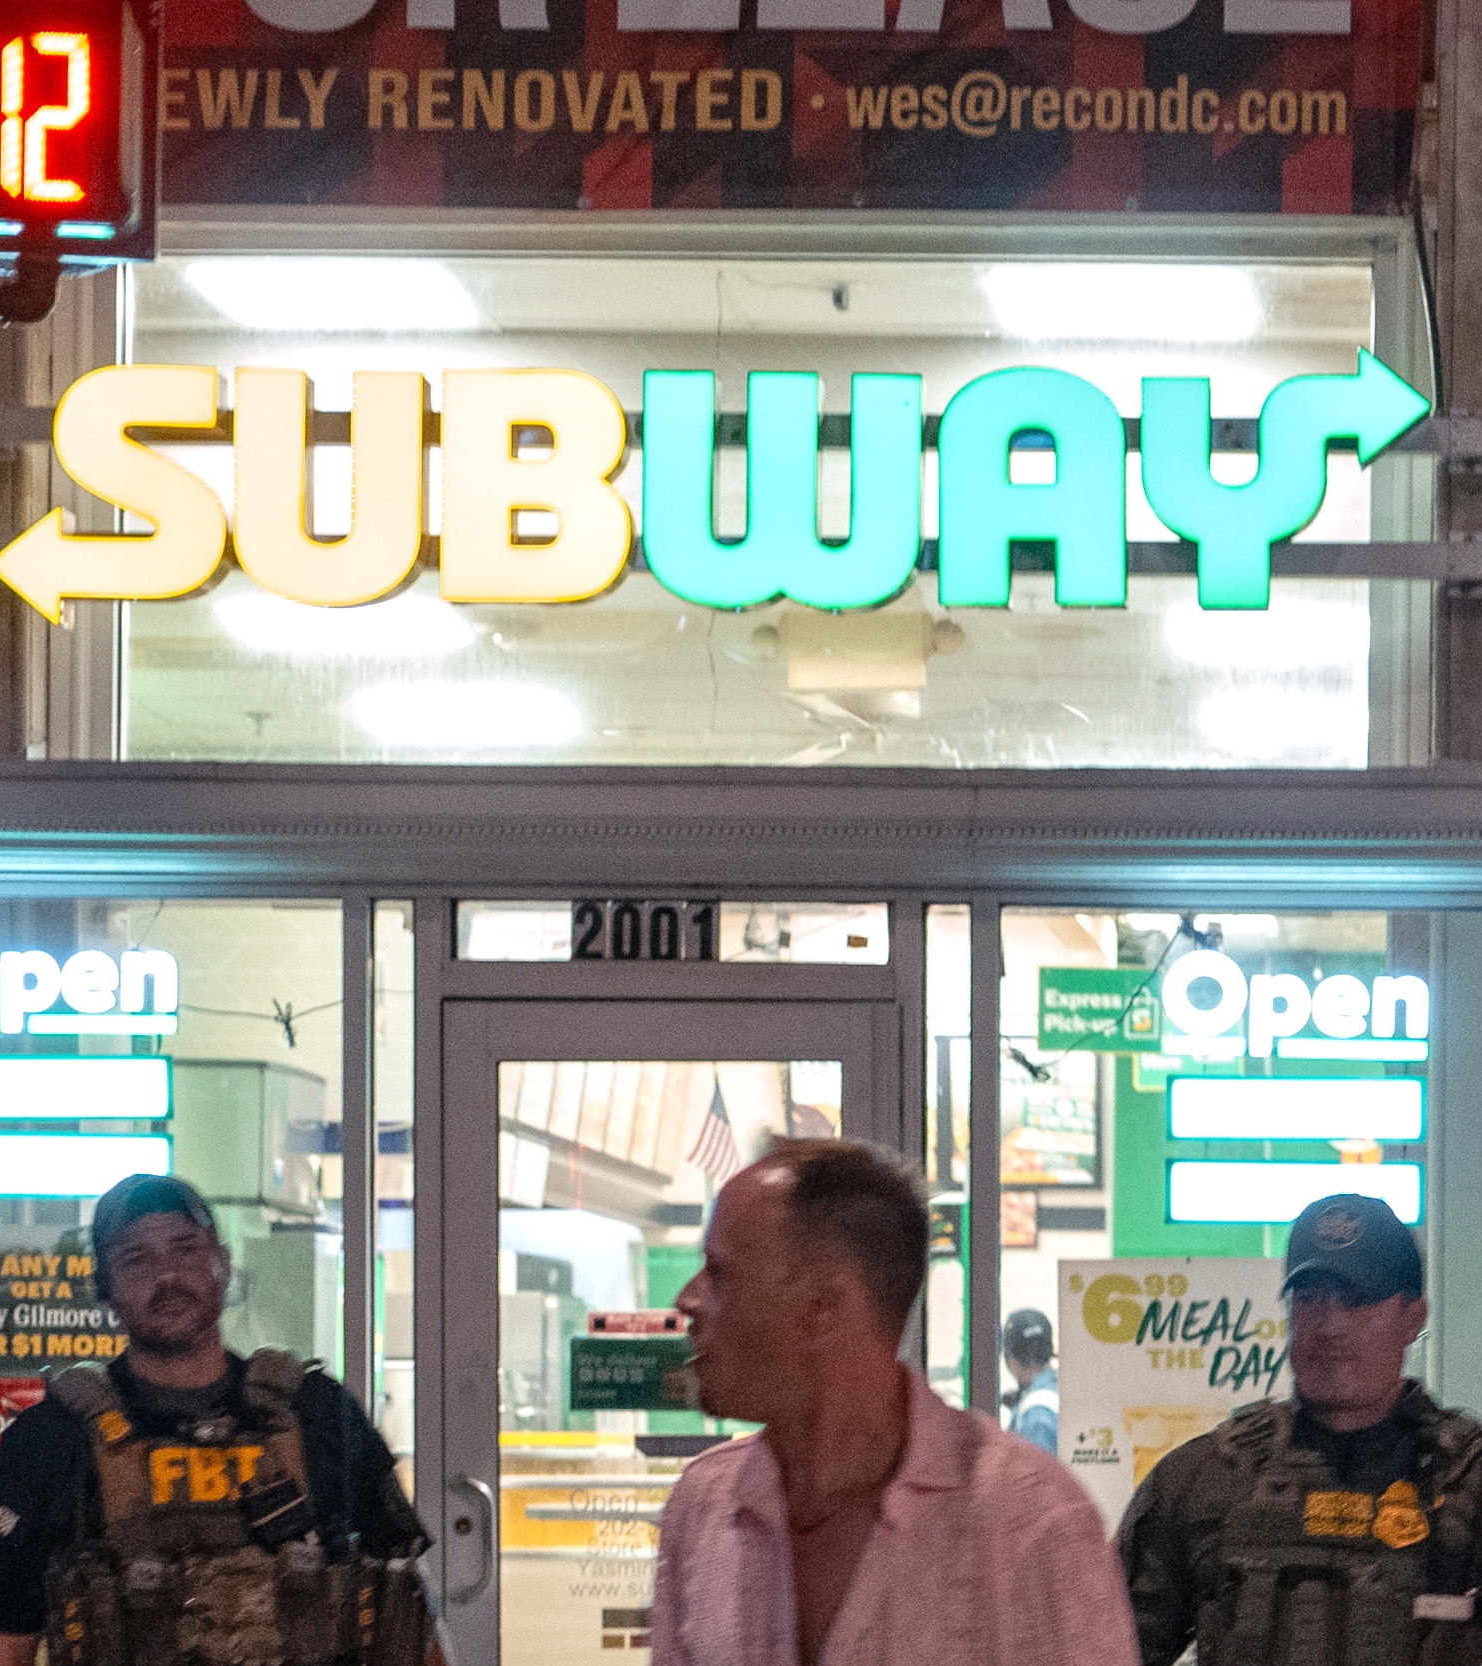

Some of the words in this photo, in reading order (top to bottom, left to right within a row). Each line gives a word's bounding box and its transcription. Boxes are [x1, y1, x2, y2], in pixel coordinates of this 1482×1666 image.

[0, 30, 92, 203] 12
[159, 68, 339, 131] EWLY
[367, 68, 784, 132] RENOVATED
[846, 69, 1348, 138] wes@recondc.com
[574, 901, 714, 961] 2001
[1044, 988, 1122, 1012] Express
[1161, 948, 1430, 1058] Open
[1043, 1013, 1118, 1037] Pick-up
[0, 1254, 62, 1278] ANY
[11, 1281, 54, 1299] GET
[55, 1282, 73, 1299] A
[12, 1303, 103, 1329] Gilmore
[1135, 1297, 1259, 1346] MEAL
[12, 1333, 43, 1360] $1
[46, 1334, 131, 1357] MORE
[1147, 1348, 1205, 1370] THE
[1207, 1343, 1289, 1397] DAY
